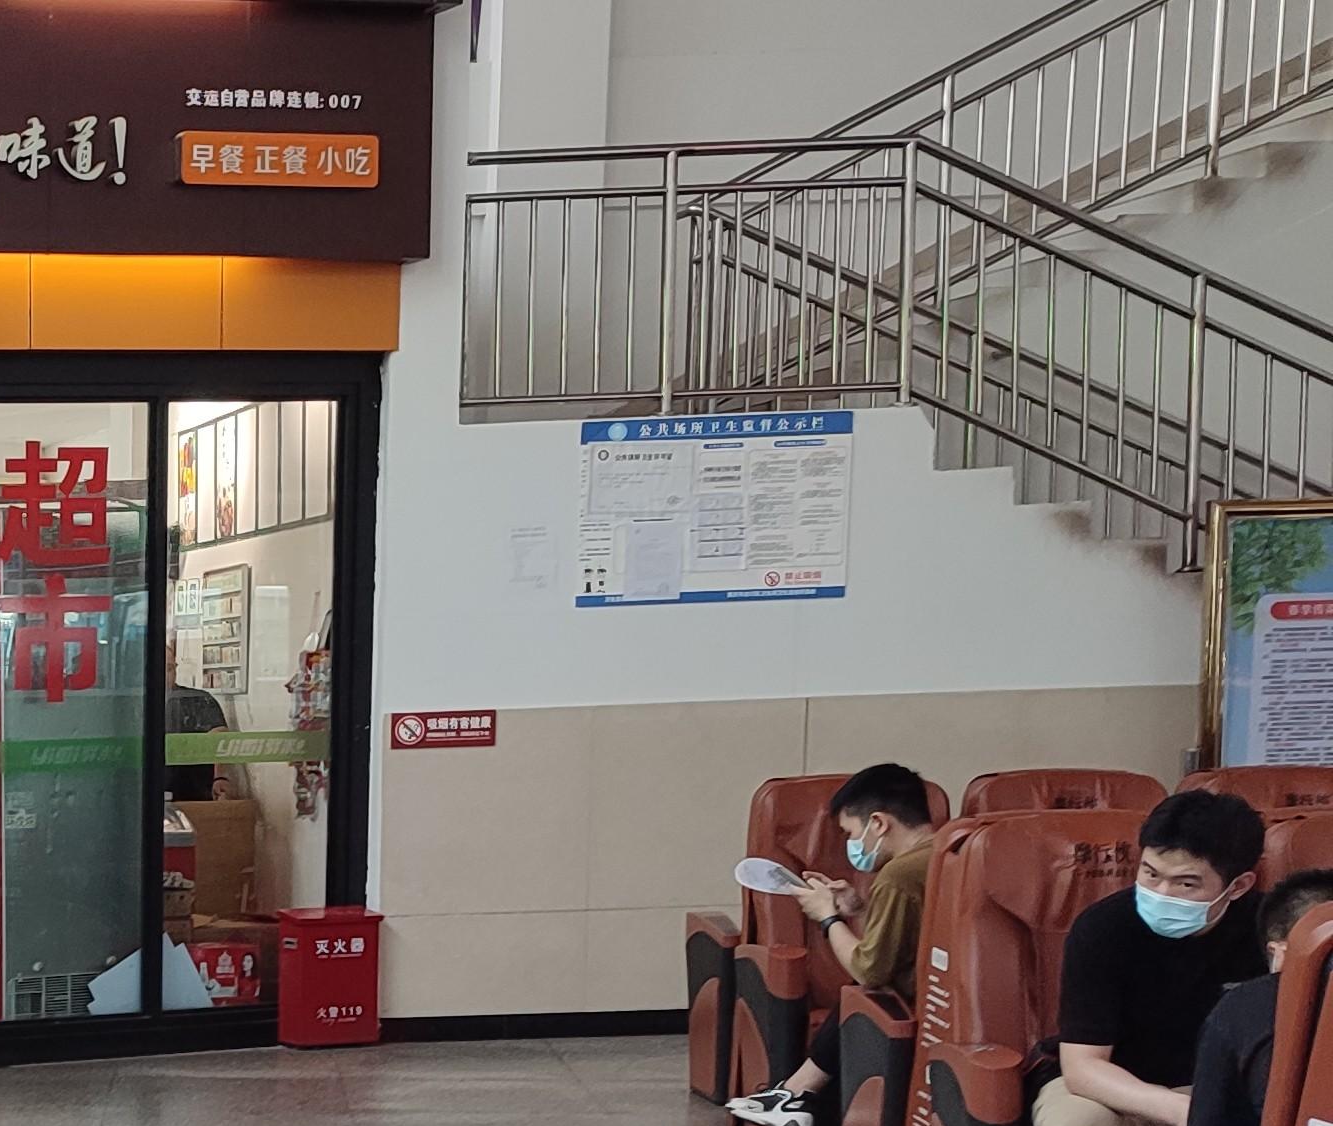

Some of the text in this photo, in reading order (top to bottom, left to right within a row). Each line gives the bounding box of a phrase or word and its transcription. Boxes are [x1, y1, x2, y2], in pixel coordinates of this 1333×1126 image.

[190, 144, 372, 176] 早餐 正餐 小吃
[315, 937, 365, 955] 灭火器
